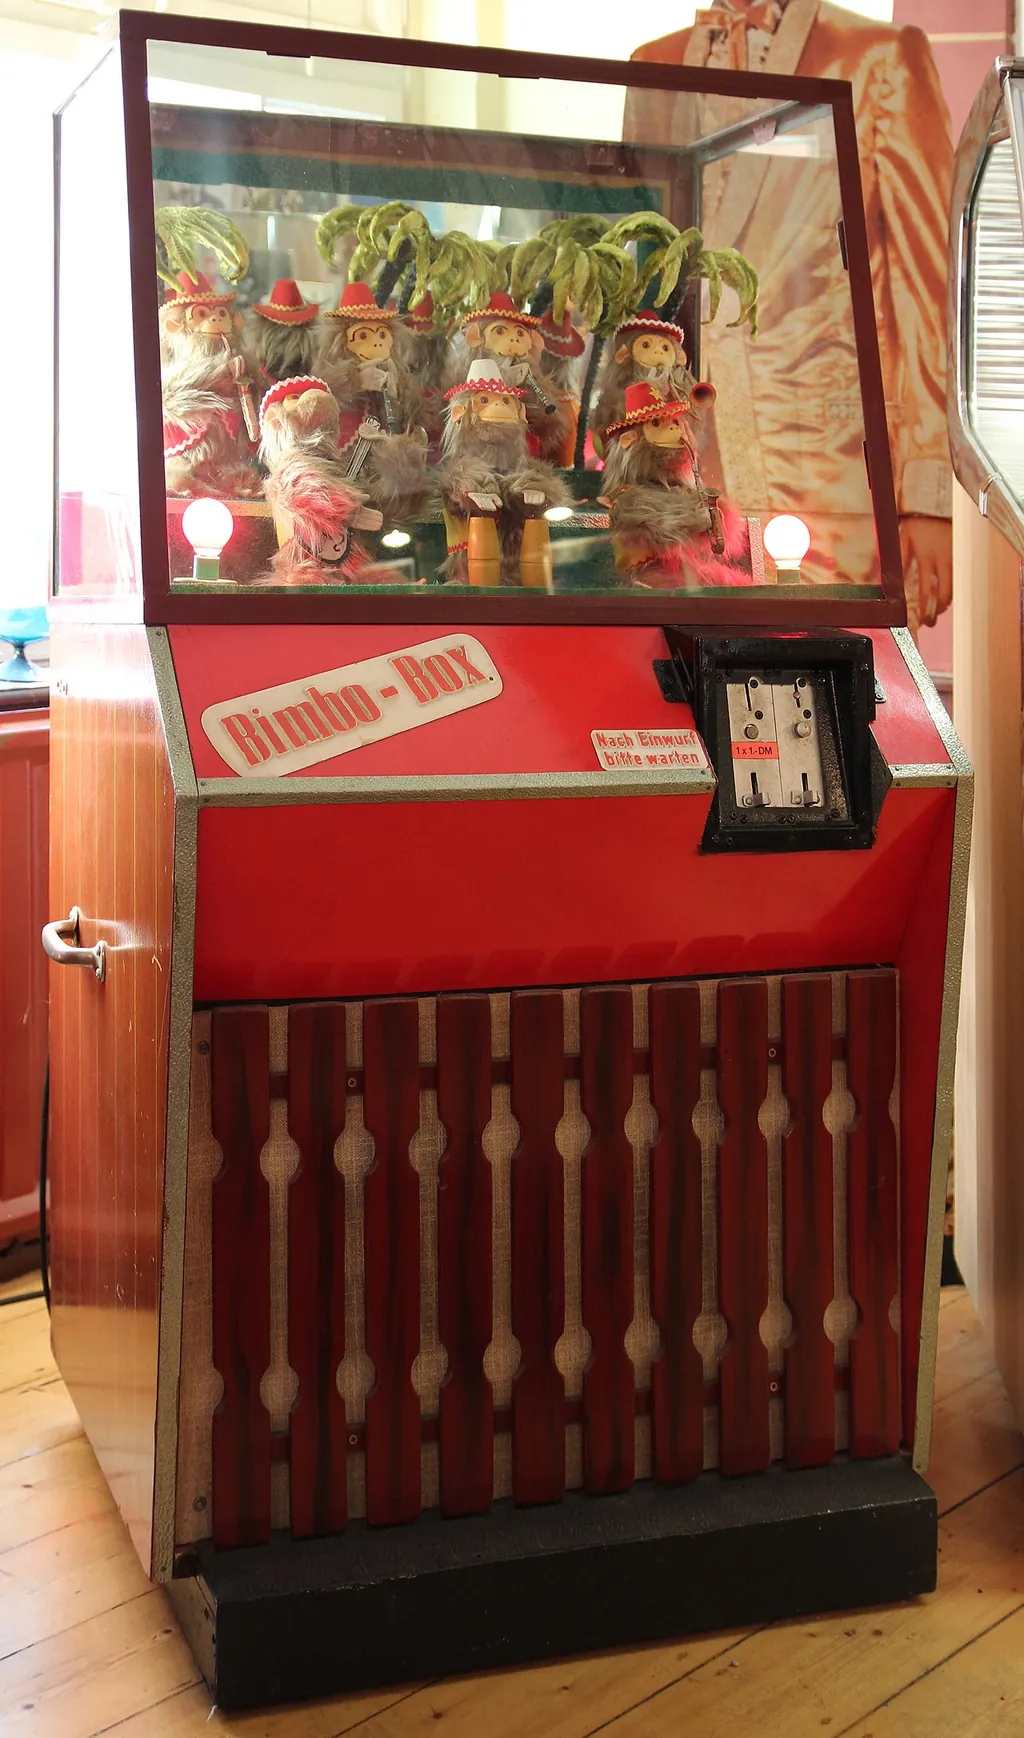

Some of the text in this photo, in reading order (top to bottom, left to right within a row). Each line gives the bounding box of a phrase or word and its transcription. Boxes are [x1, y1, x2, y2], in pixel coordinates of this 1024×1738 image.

[219, 683, 383, 767] Bimbo
[390, 645, 487, 705] Box
[595, 731, 697, 747] Nach Einwurf
[603, 750, 700, 766] bitte warten
